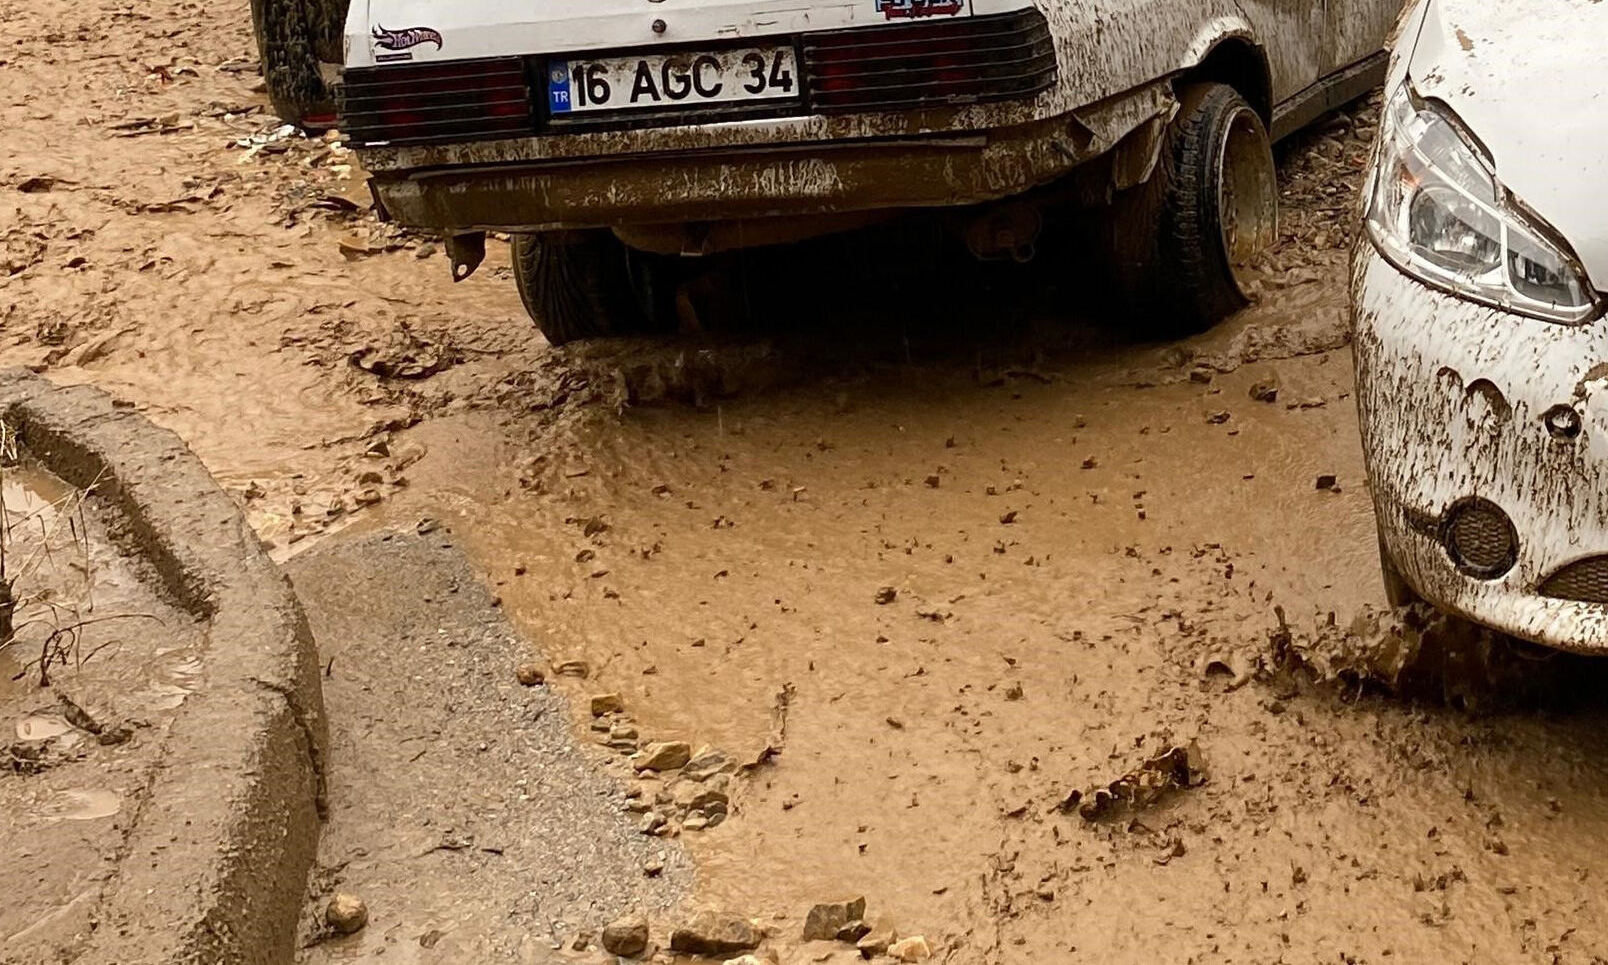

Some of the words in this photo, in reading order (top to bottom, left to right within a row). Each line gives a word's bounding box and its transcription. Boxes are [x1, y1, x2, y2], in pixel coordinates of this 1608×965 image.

[553, 91, 569, 103] TR
[572, 63, 612, 107] 16
[629, 55, 724, 104] AGC
[741, 51, 793, 95] 34
